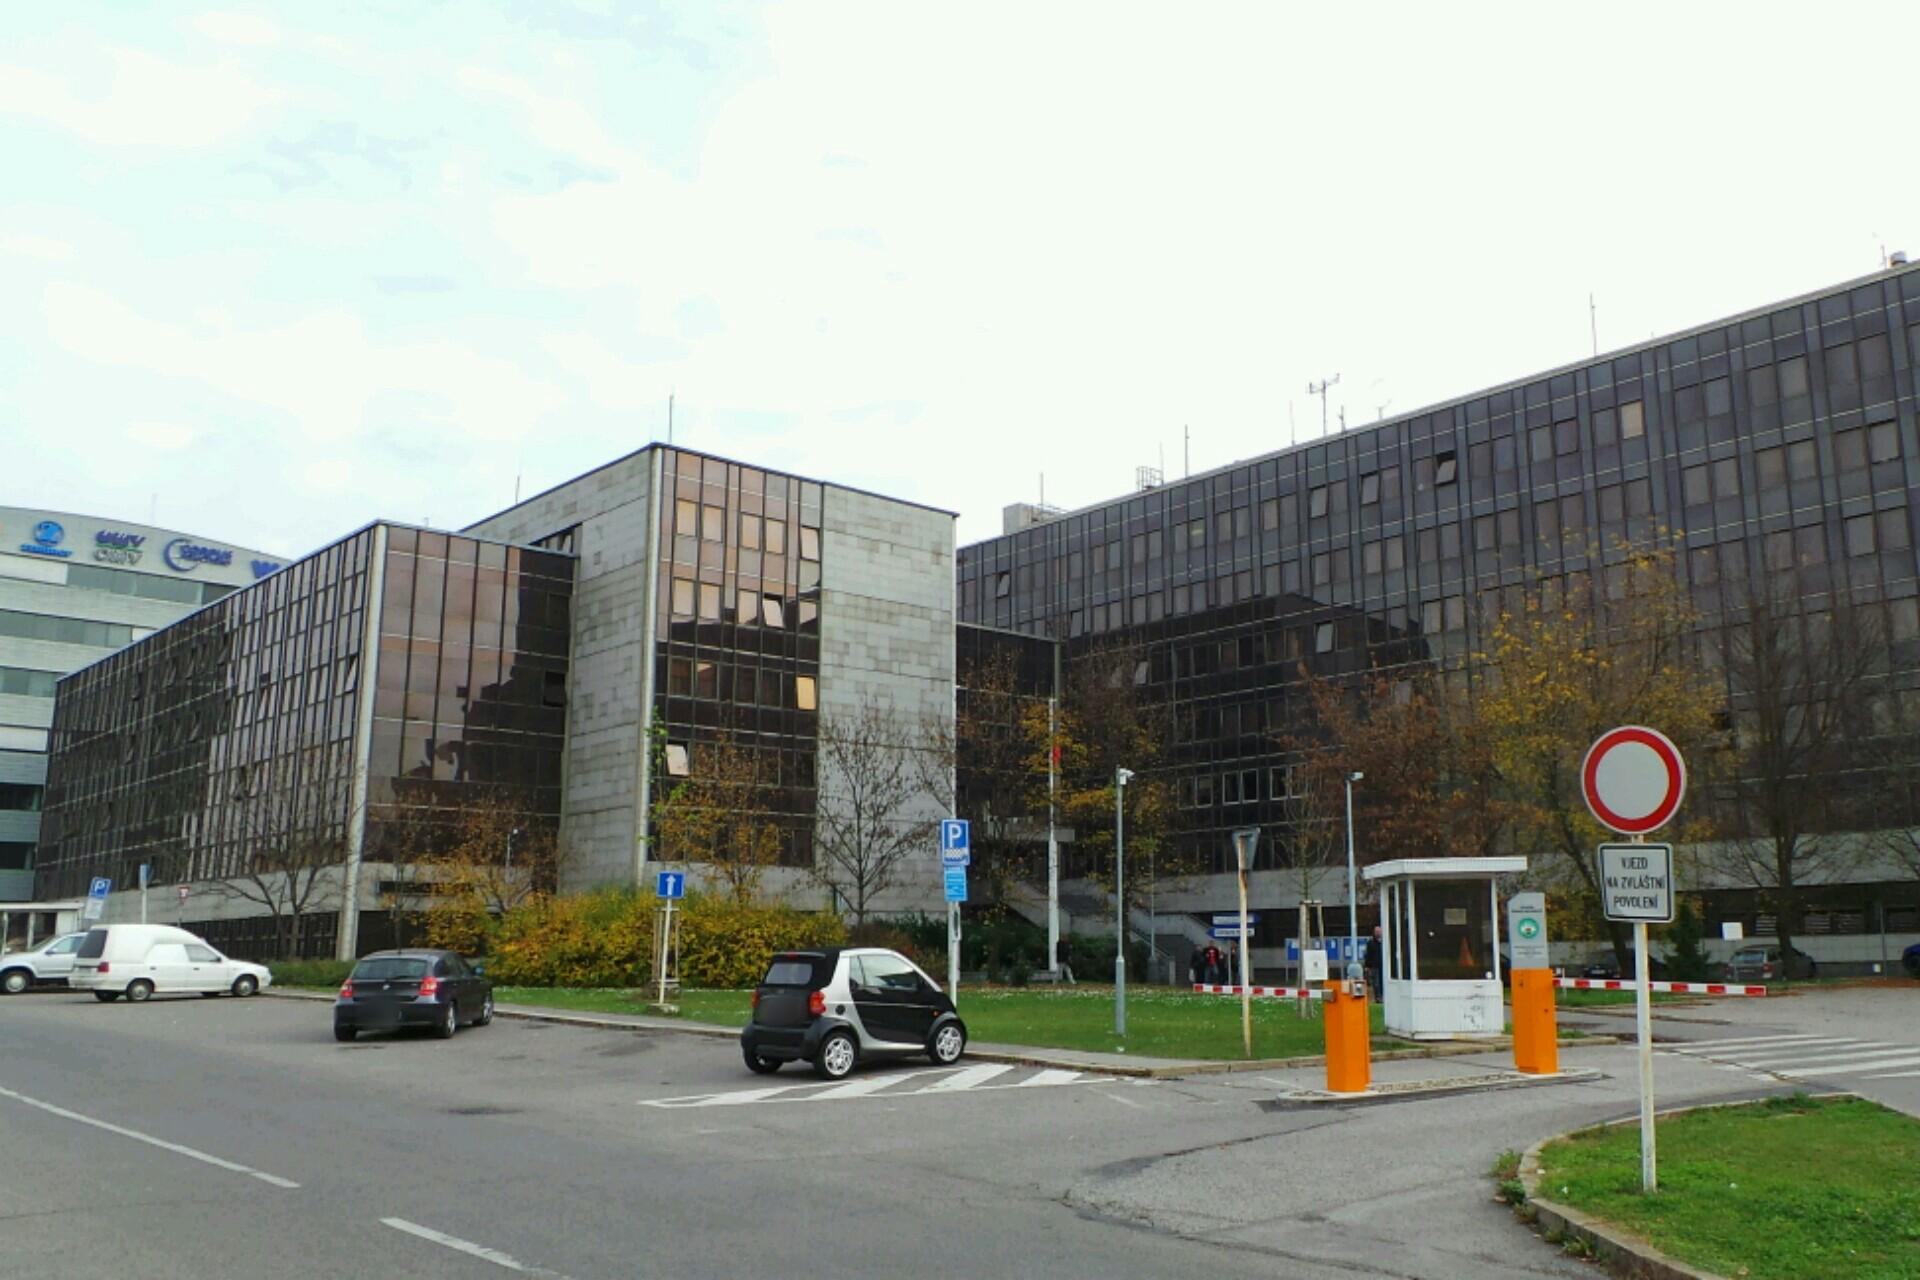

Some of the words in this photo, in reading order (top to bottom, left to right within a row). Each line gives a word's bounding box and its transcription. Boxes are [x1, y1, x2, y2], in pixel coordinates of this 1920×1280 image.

[948, 823, 962, 848] P
[1621, 856, 1648, 870] VJEZD
[94, 879, 105, 894] P
[1606, 876, 1618, 888] NA
[1613, 893, 1658, 909] POVOLENÍ
